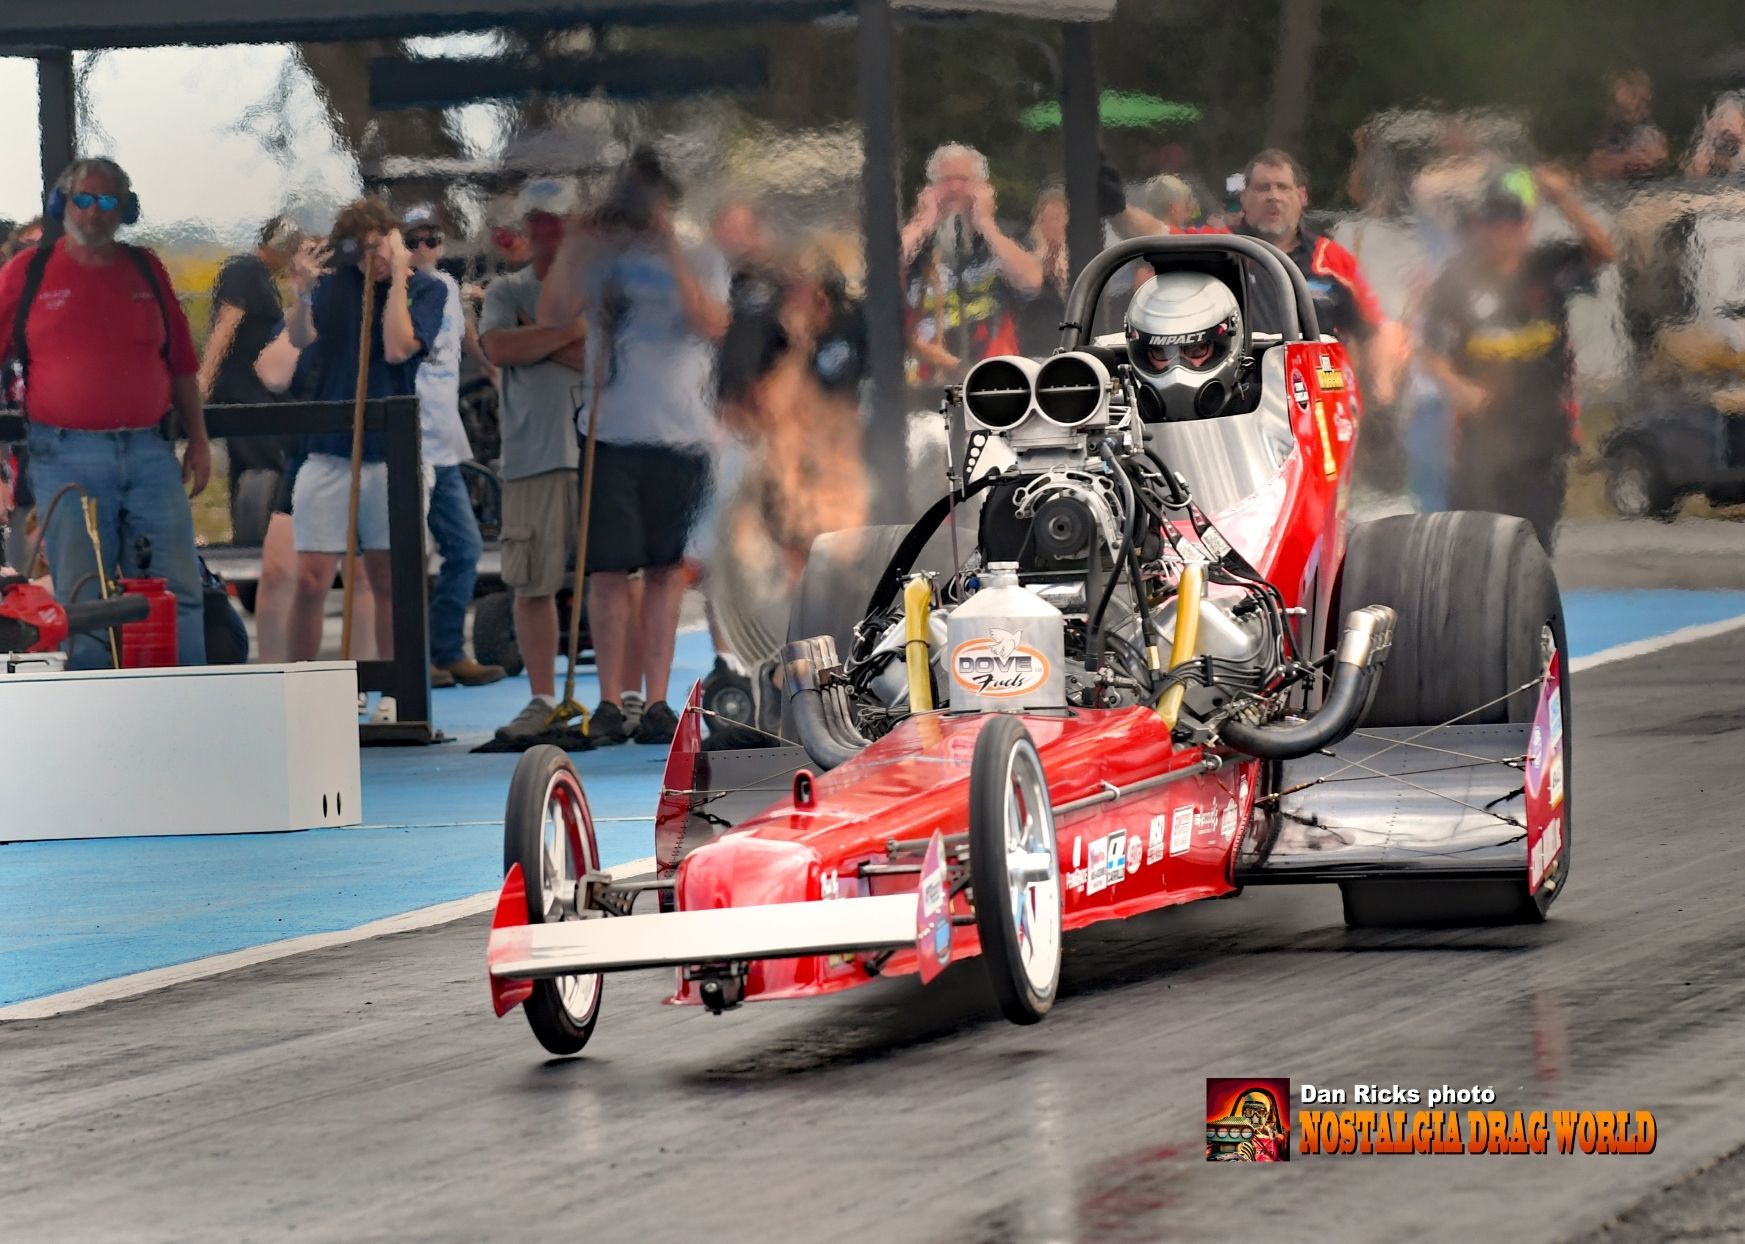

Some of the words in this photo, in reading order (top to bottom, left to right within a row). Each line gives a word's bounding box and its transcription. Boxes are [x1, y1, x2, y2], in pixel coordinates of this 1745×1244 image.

[1148, 331, 1206, 346] IMPACT
[959, 656, 1032, 673] DOVE
[972, 673, 1025, 693] Fuels
